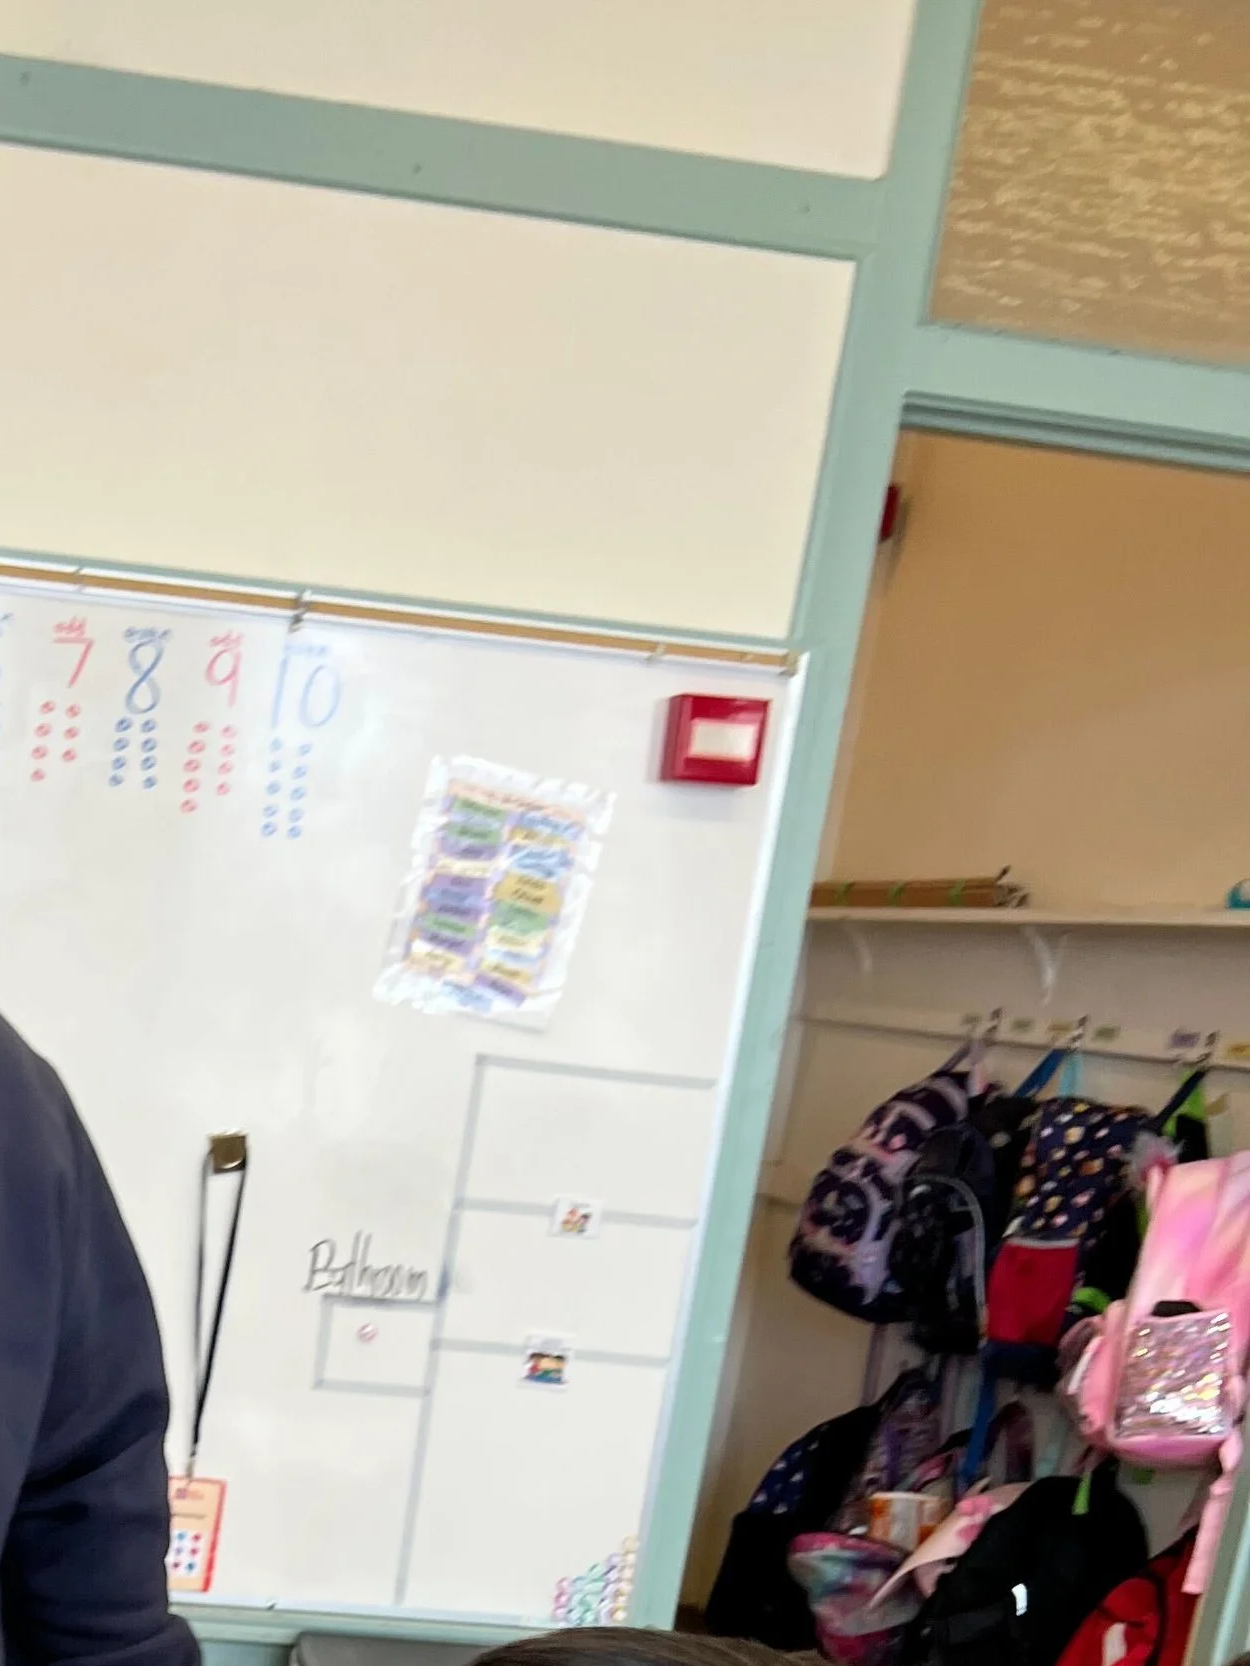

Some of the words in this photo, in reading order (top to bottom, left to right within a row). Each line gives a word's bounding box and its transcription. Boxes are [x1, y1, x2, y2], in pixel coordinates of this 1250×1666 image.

[51, 636, 94, 689] 7
[124, 639, 165, 715] 8
[205, 648, 242, 708] 9
[271, 654, 343, 730] 10
